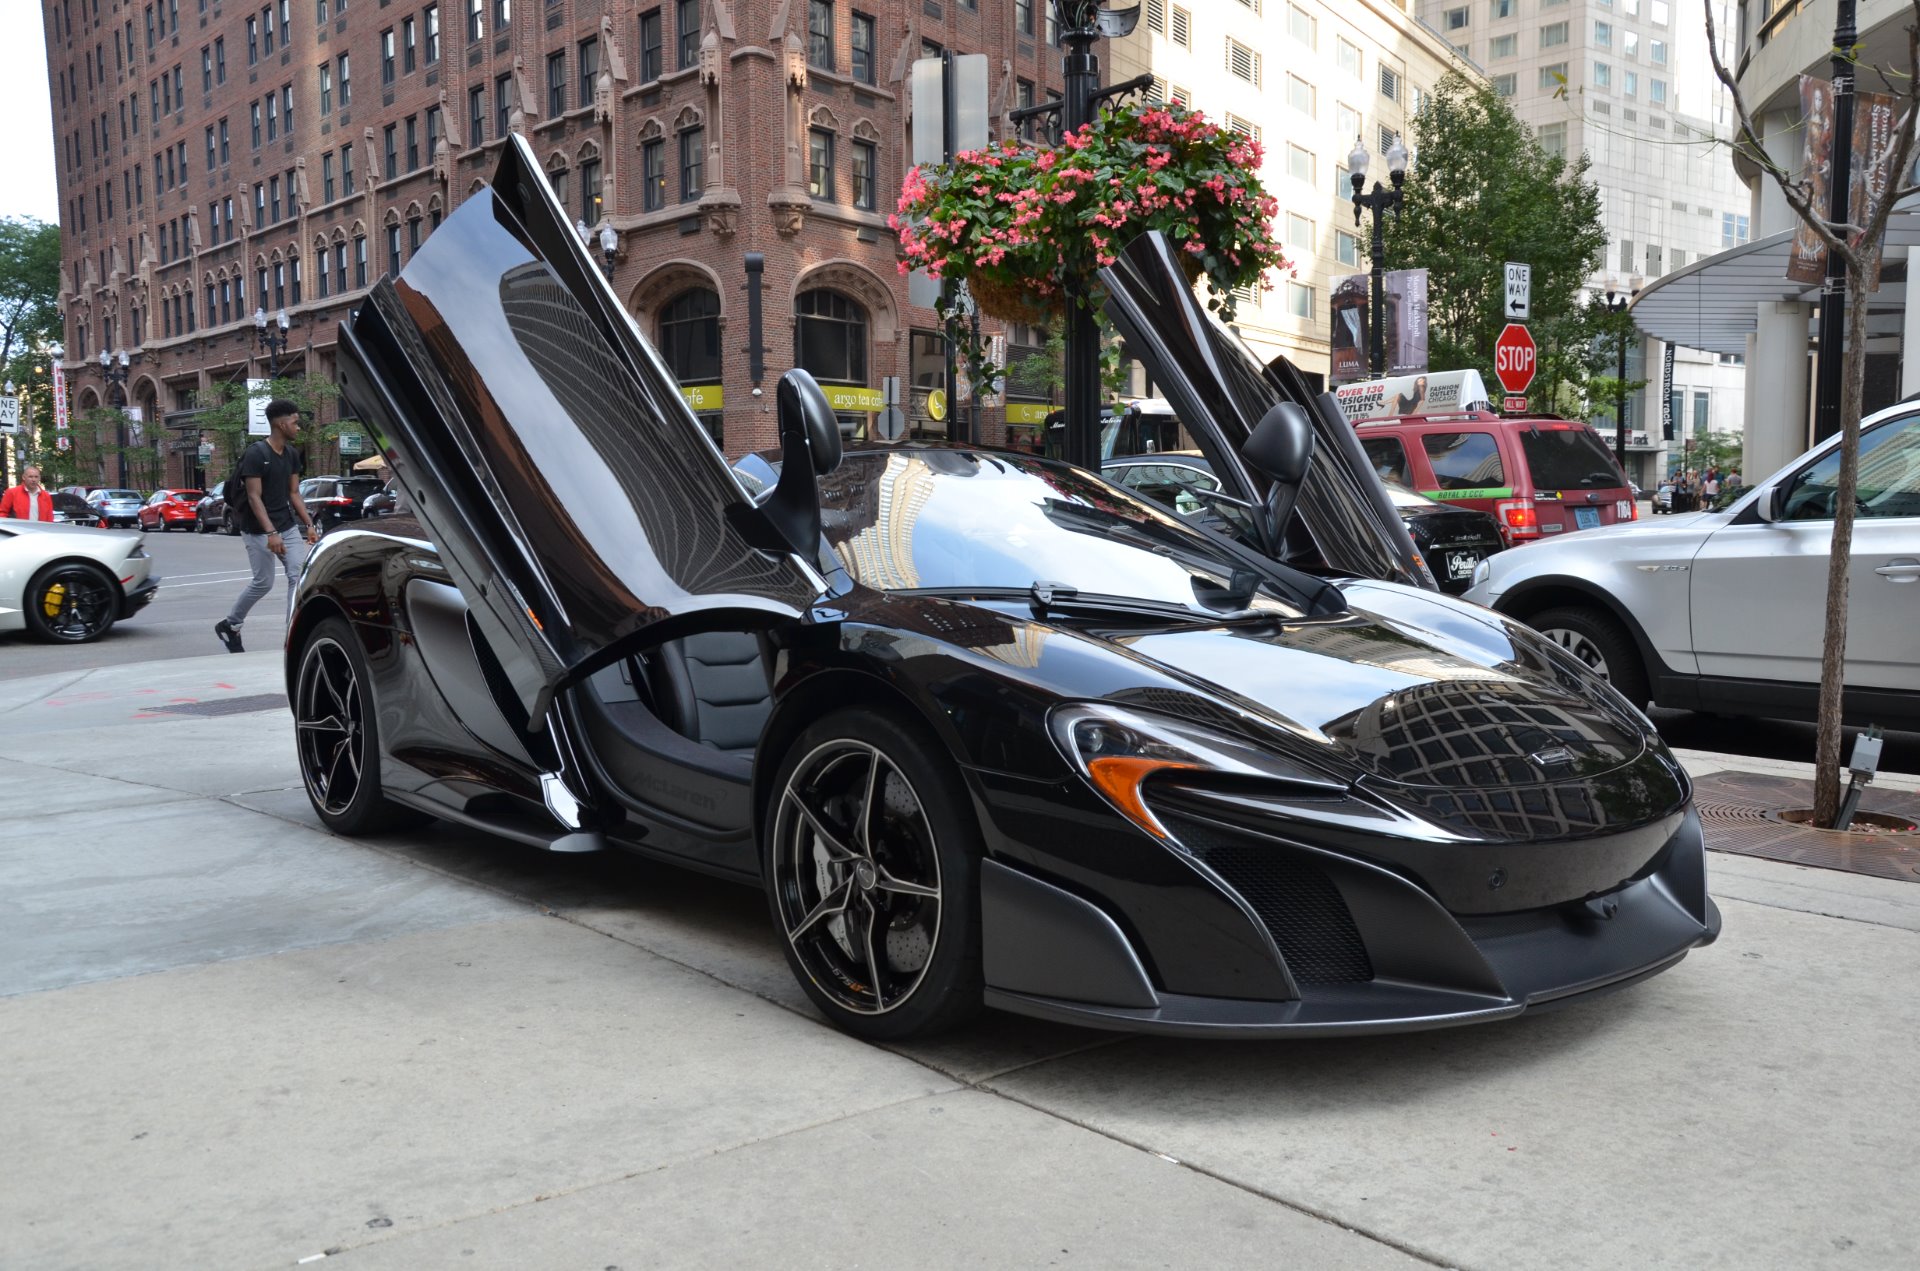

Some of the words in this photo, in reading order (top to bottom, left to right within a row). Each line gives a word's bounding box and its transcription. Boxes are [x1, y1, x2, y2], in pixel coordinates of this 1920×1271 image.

[1508, 268, 1527, 282] ONE
[1508, 283, 1527, 297] WAY
[1498, 345, 1534, 371] STOP
[1663, 349, 1673, 403] NORDSTROM
[1338, 388, 1363, 398] OVER
[1367, 385, 1384, 394] 130
[1430, 384, 1460, 392] FASHION
[1430, 390, 1457, 398] OUTLETS
[0, 401, 15, 409] NE
[834, 393, 857, 408] argo
[858, 393, 871, 406] tea
[1428, 395, 1458, 403] CHICAGO
[1506, 400, 1515, 408] ALL
[1515, 400, 1525, 408] WAY
[1343, 403, 1374, 414] UTLETS
[1663, 403, 1673, 425] rack
[0, 411, 15, 419] AY
[1469, 490, 1484, 498] CCC
[1616, 501, 1632, 519] 1164
